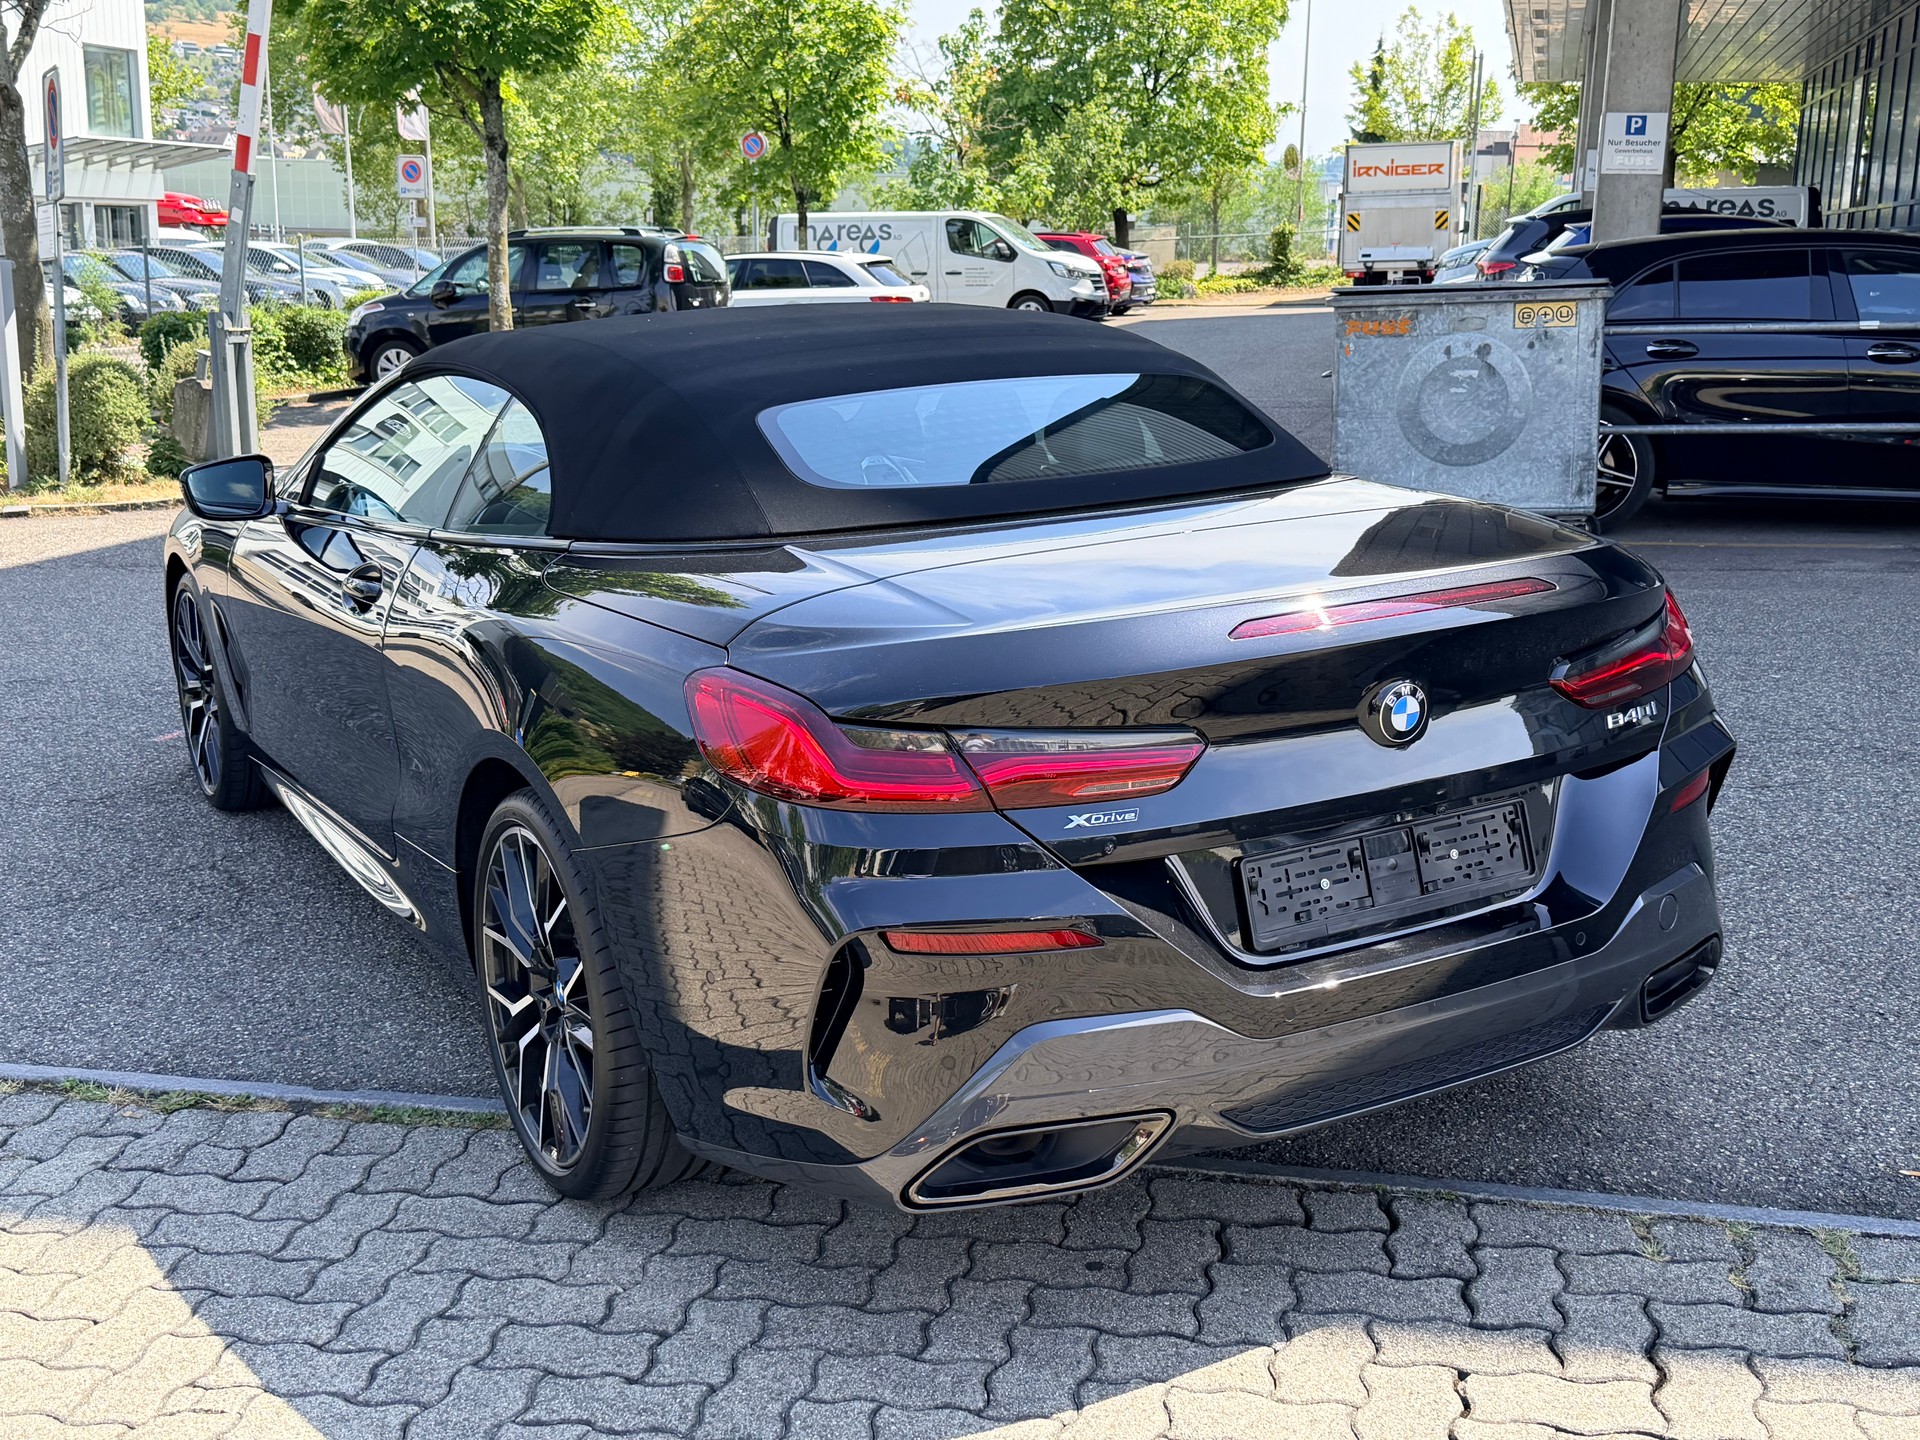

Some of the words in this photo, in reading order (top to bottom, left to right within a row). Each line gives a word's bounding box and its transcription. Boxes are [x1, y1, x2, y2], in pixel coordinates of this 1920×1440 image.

[1607, 139, 1623, 147] Nur
[1625, 139, 1661, 147] Besucher
[1775, 210, 1787, 218] AG
[1386, 685, 1425, 707] BMW
